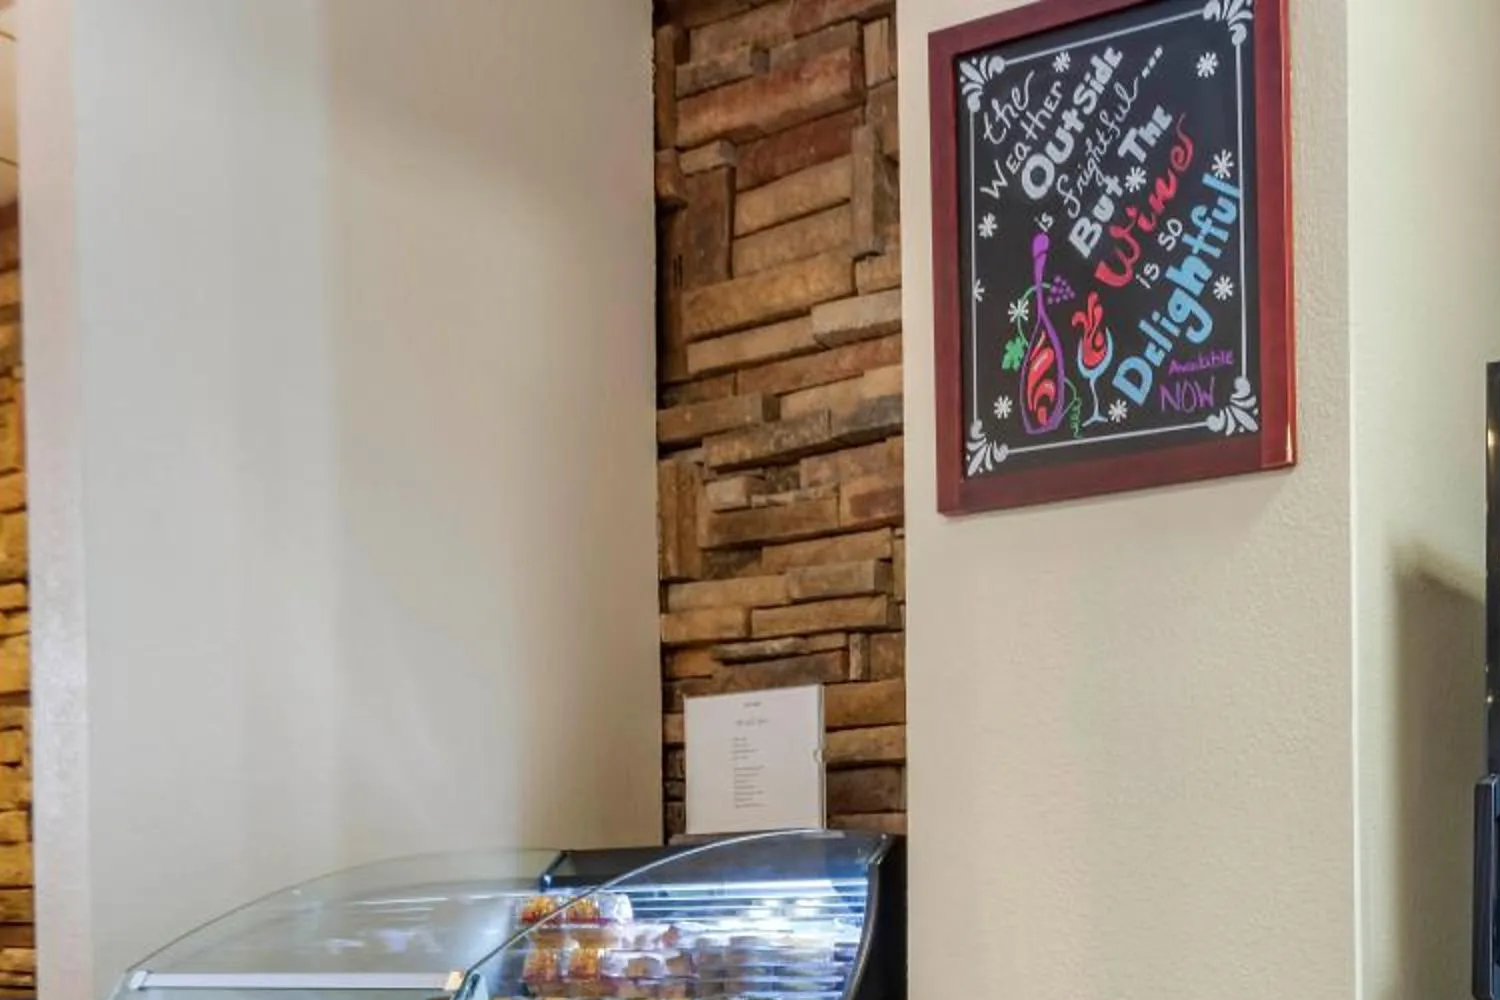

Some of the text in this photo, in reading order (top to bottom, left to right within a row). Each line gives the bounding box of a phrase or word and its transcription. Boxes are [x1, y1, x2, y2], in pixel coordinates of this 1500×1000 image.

[1034, 211, 1054, 232] is
[1135, 262, 1160, 289] is
[1159, 376, 1216, 413] NOW
